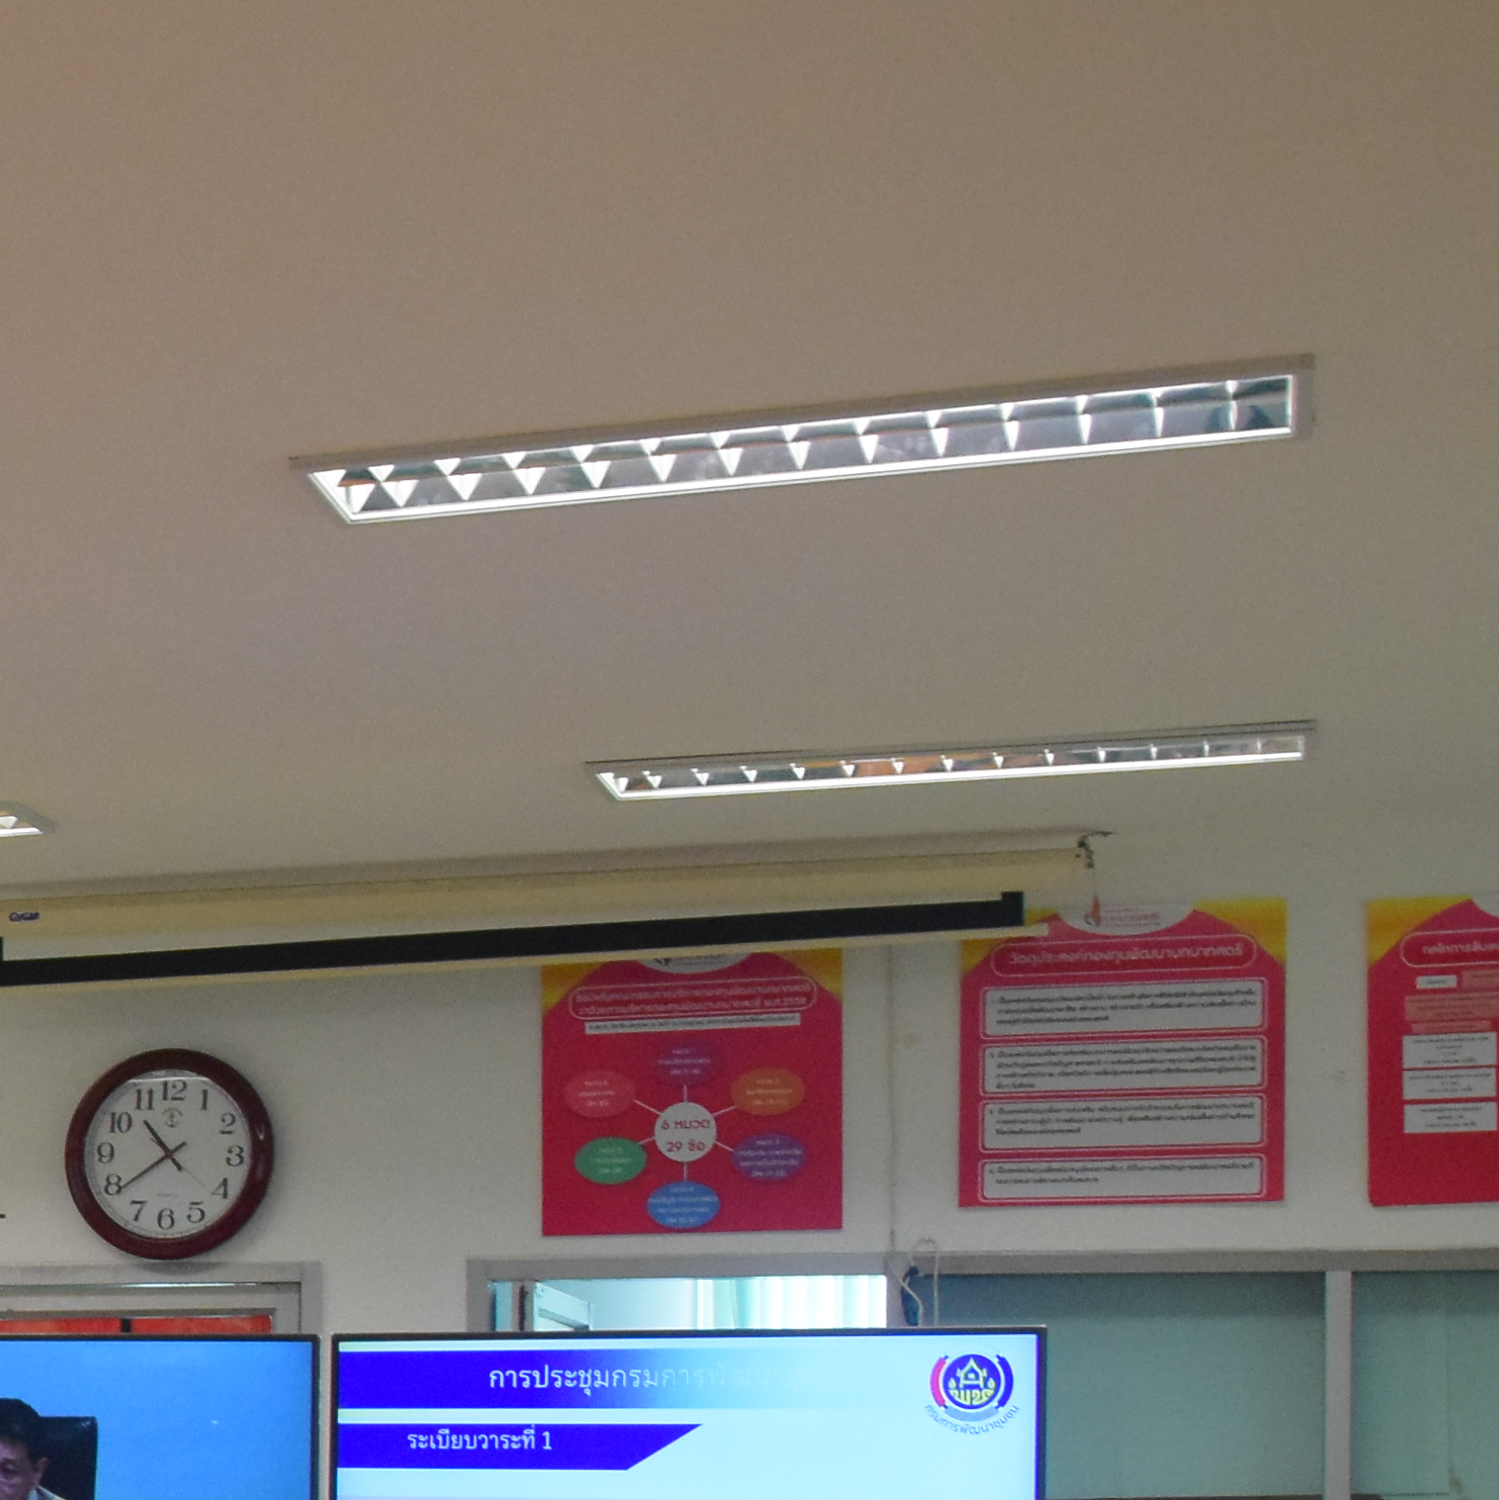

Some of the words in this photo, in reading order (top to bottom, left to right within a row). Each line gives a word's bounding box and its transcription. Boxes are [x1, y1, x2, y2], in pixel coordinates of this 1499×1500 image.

[134, 1088, 155, 1111] 11
[161, 1080, 187, 1101] 12
[200, 1089, 209, 1111] 1
[109, 1111, 133, 1134] 10
[220, 1113, 236, 1135] 2
[97, 1143, 115, 1164] 9
[226, 1145, 244, 1167] 3
[666, 1141, 683, 1153] 29
[105, 1174, 122, 1196] 8
[211, 1178, 229, 1199] 4
[130, 1201, 148, 1222] 7
[157, 1208, 175, 1230] 6
[187, 1202, 206, 1223] 5
[407, 1424, 536, 1450] ระเบียบวาระที่
[542, 1431, 553, 1450] 1
